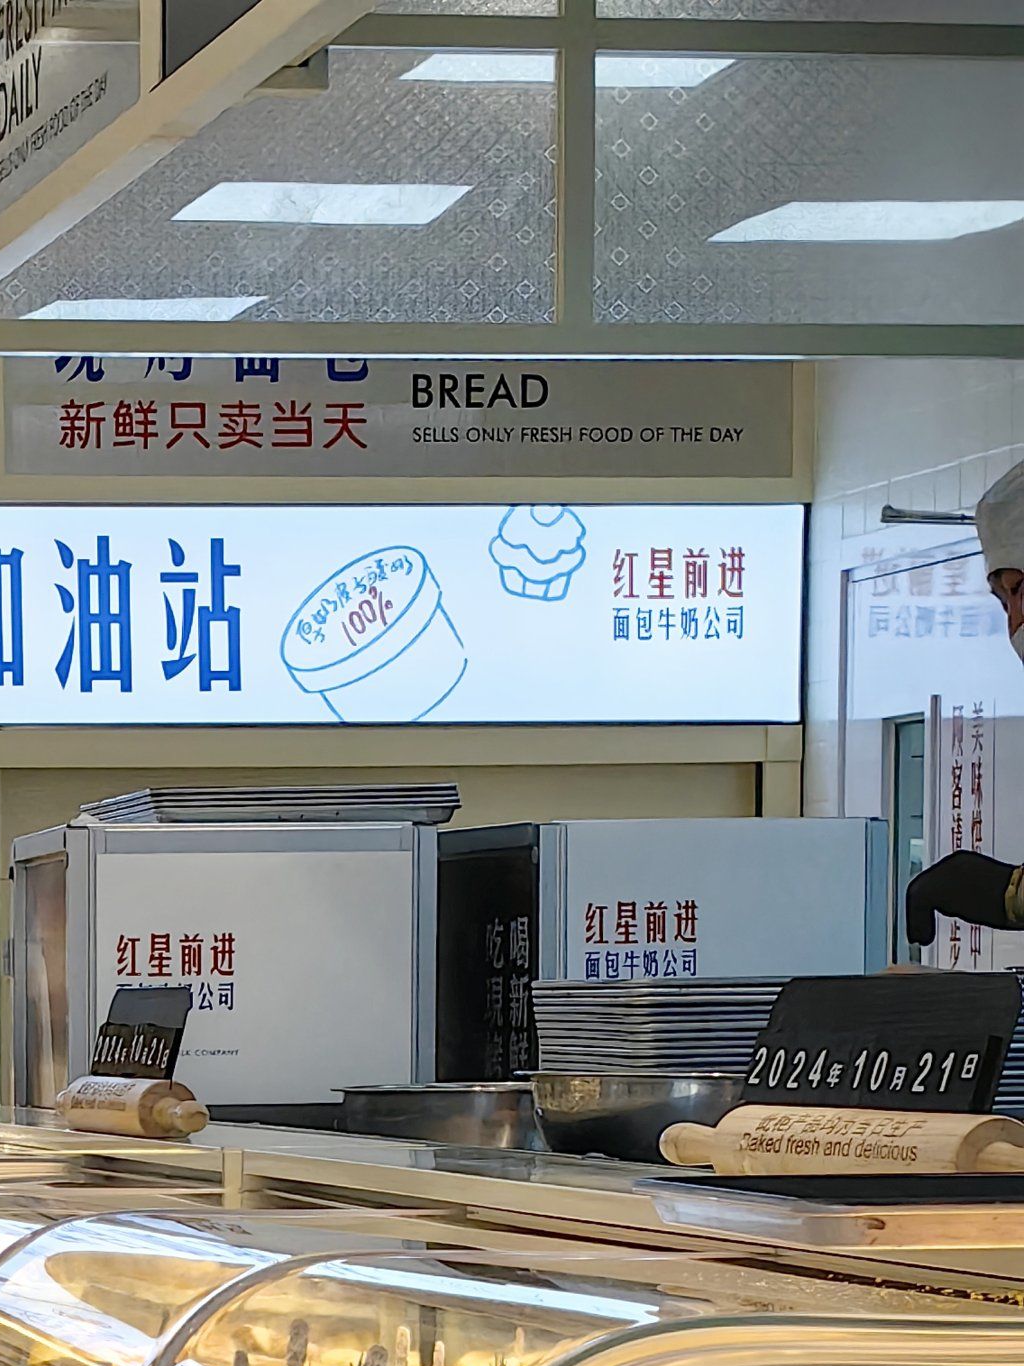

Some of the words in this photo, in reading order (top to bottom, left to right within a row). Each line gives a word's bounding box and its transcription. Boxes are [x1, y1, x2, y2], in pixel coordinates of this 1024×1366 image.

[412, 373, 549, 409] BREAD
[59, 399, 367, 449] 新鲜只卖当天
[412, 426, 459, 443] SELLS
[466, 426, 514, 443] ONLY
[521, 426, 572, 443] FRESH
[579, 426, 632, 443] FOOD
[640, 426, 664, 443] OF
[670, 426, 703, 443] THE
[709, 426, 744, 443] DAY
[613, 547, 746, 599] 红星前进
[612, 605, 745, 641] 面包牛奶公司
[584, 900, 699, 945] 红星前进
[116, 932, 236, 977] 红星前进
[584, 949, 697, 980] 面包牛奶公司
[748, 1046, 979, 1093] 2024年10月21日
[785, 1134, 820, 1155] fresh
[823, 1137, 853, 1158] and
[854, 1138, 918, 1162] delicious
